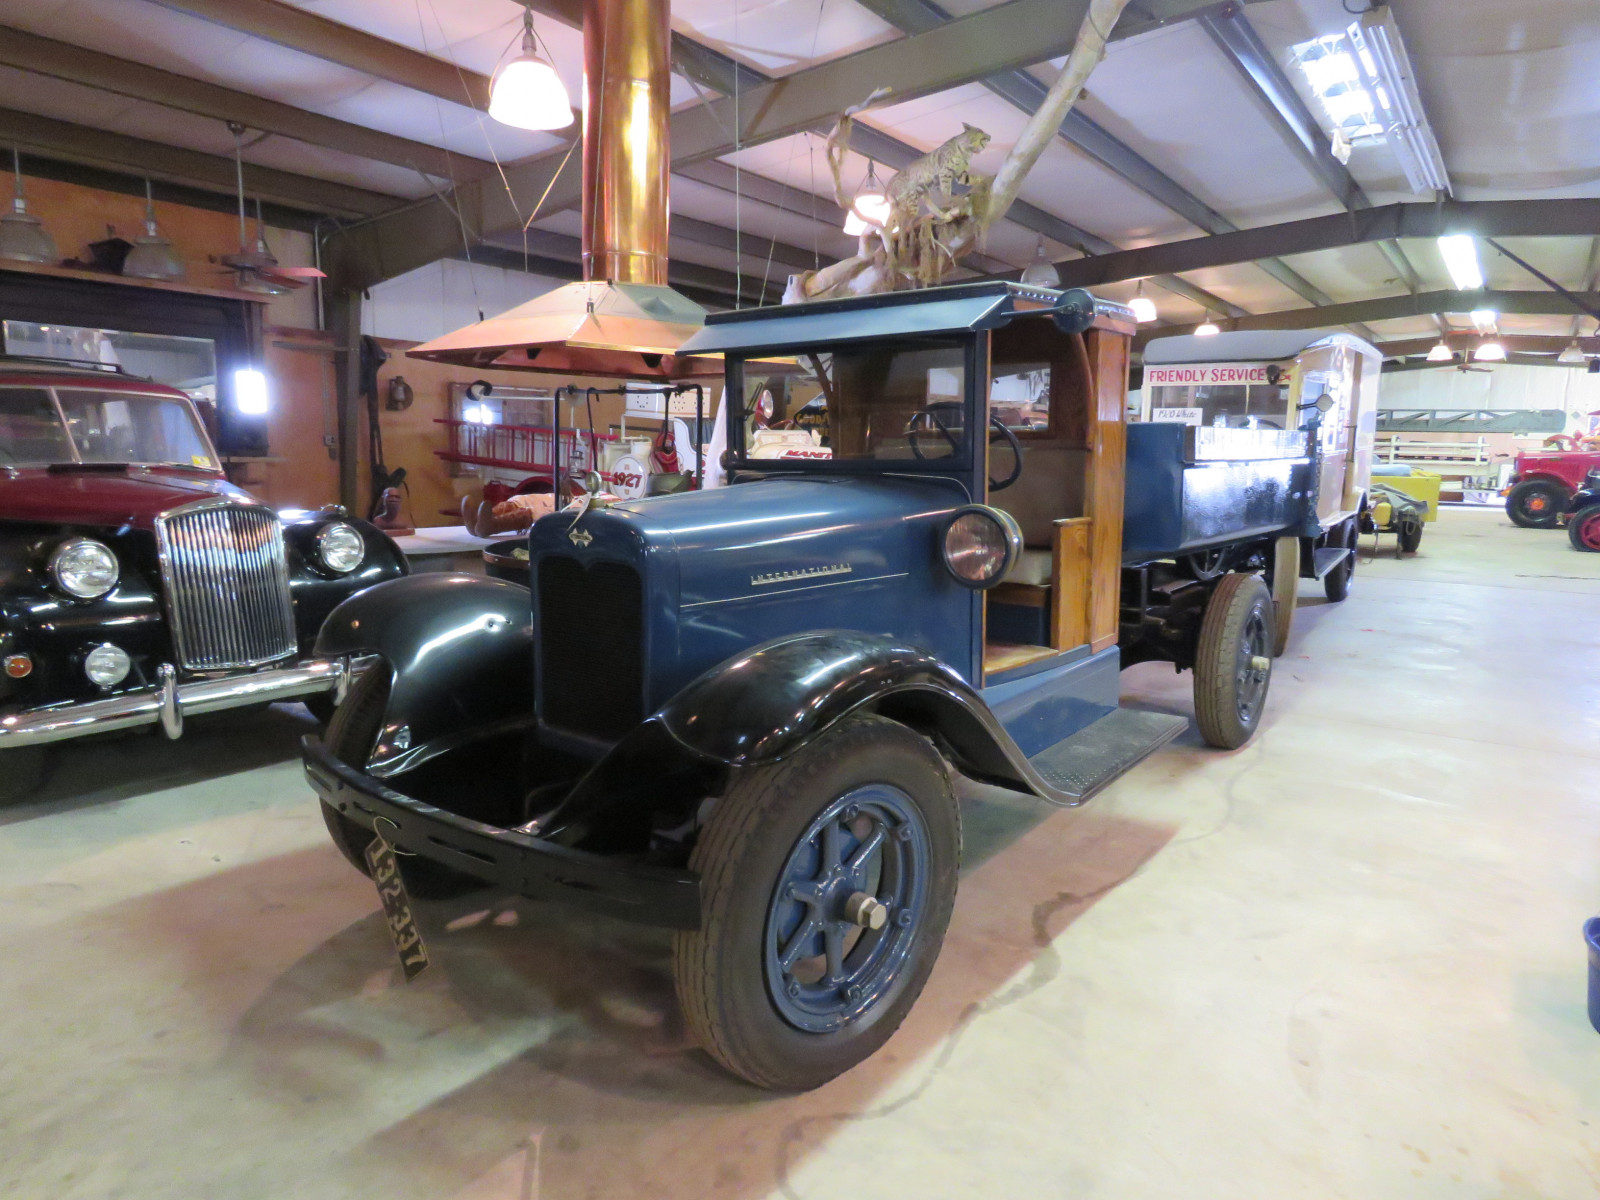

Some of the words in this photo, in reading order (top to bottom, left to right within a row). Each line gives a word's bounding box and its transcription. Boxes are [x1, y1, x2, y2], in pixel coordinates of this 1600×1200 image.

[1149, 369, 1207, 383] FRIENDLY
[1211, 368, 1265, 382] SERVICE
[613, 471, 643, 489] 1927
[750, 563, 852, 586] INTERNATIONAL
